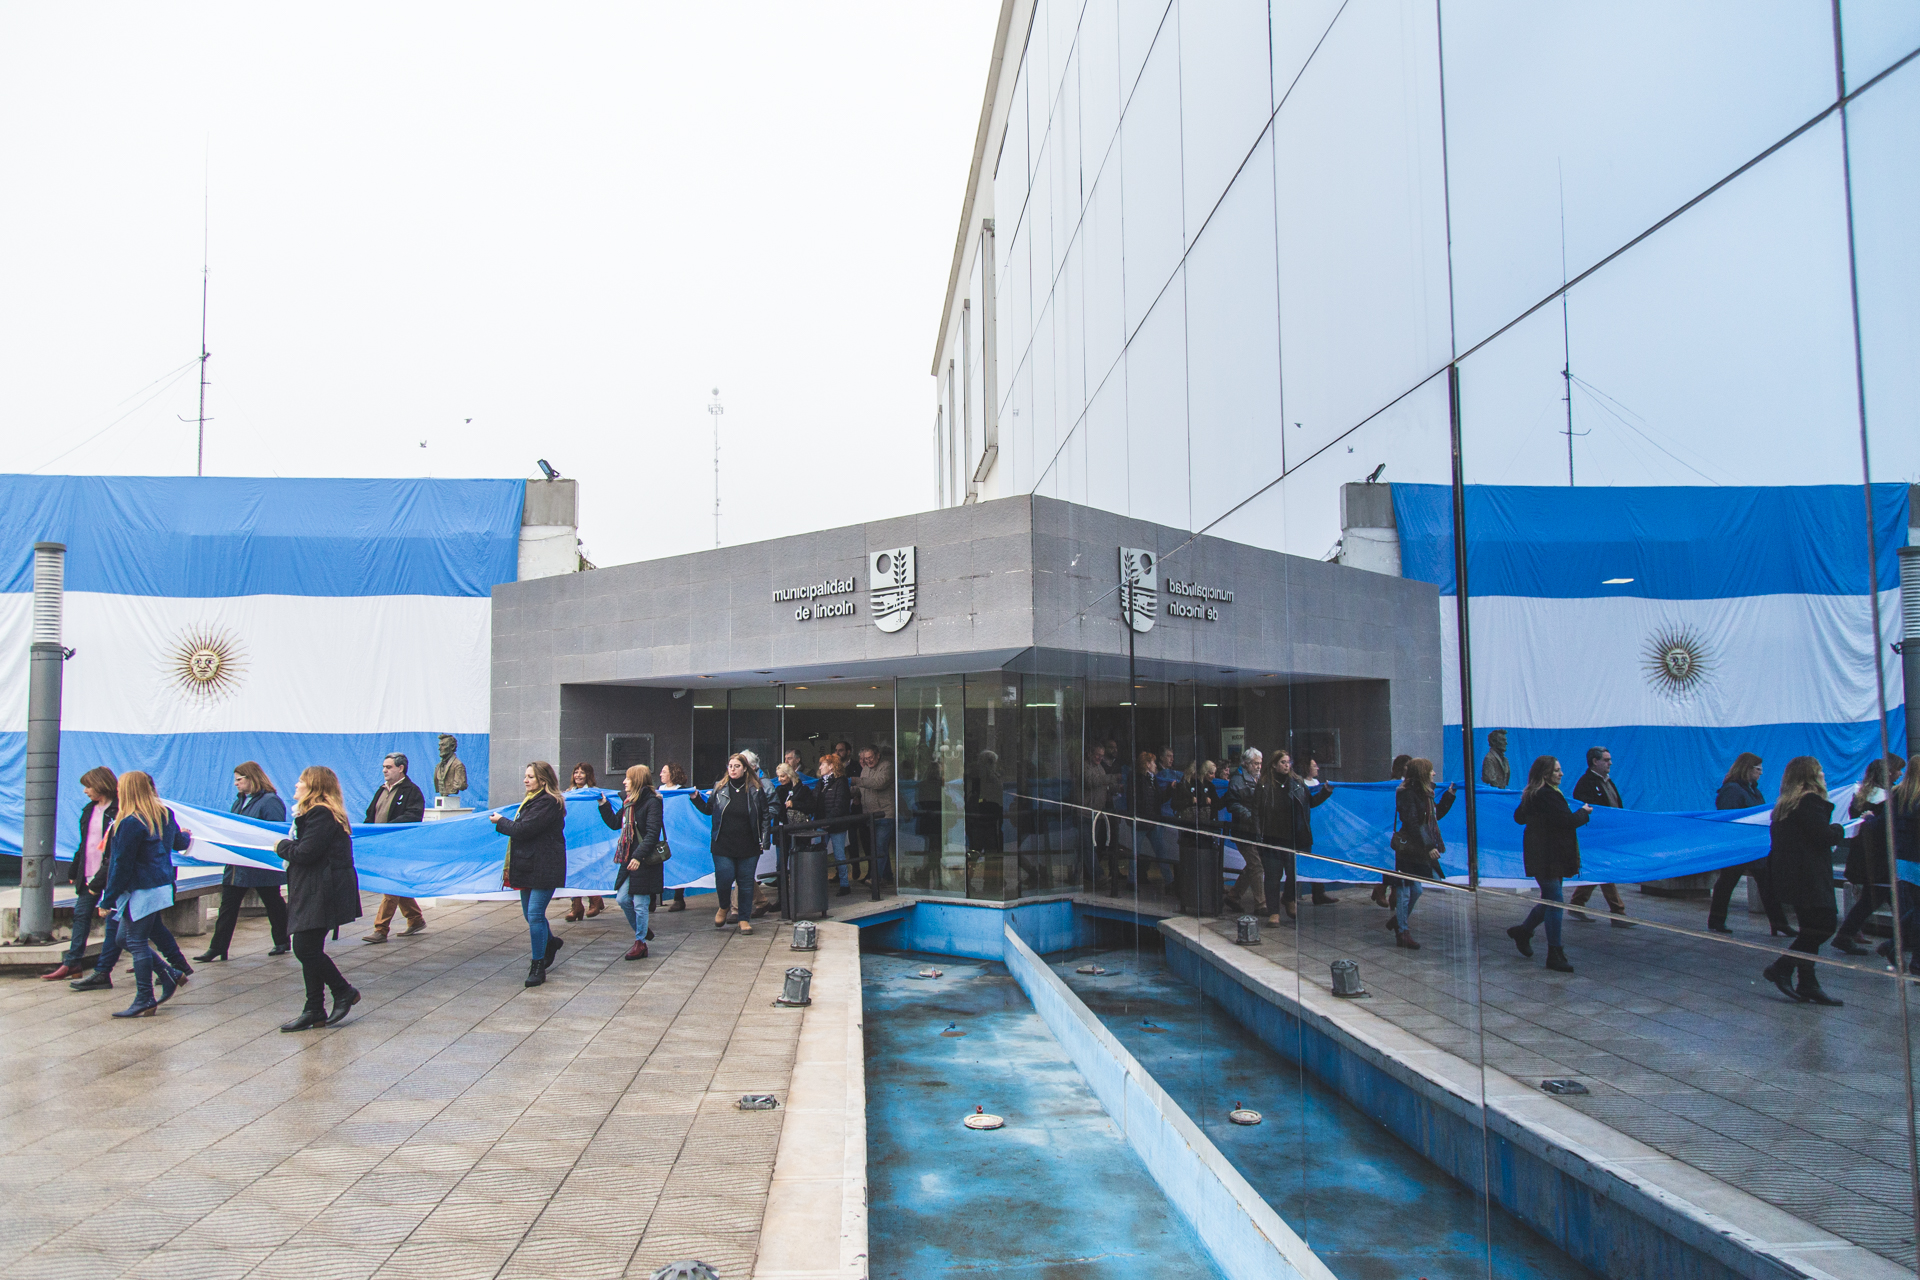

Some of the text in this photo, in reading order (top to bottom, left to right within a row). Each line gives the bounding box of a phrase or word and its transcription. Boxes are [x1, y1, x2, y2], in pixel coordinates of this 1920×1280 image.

[772, 577, 854, 601] municipalidad
[795, 600, 854, 621] de lincoln
